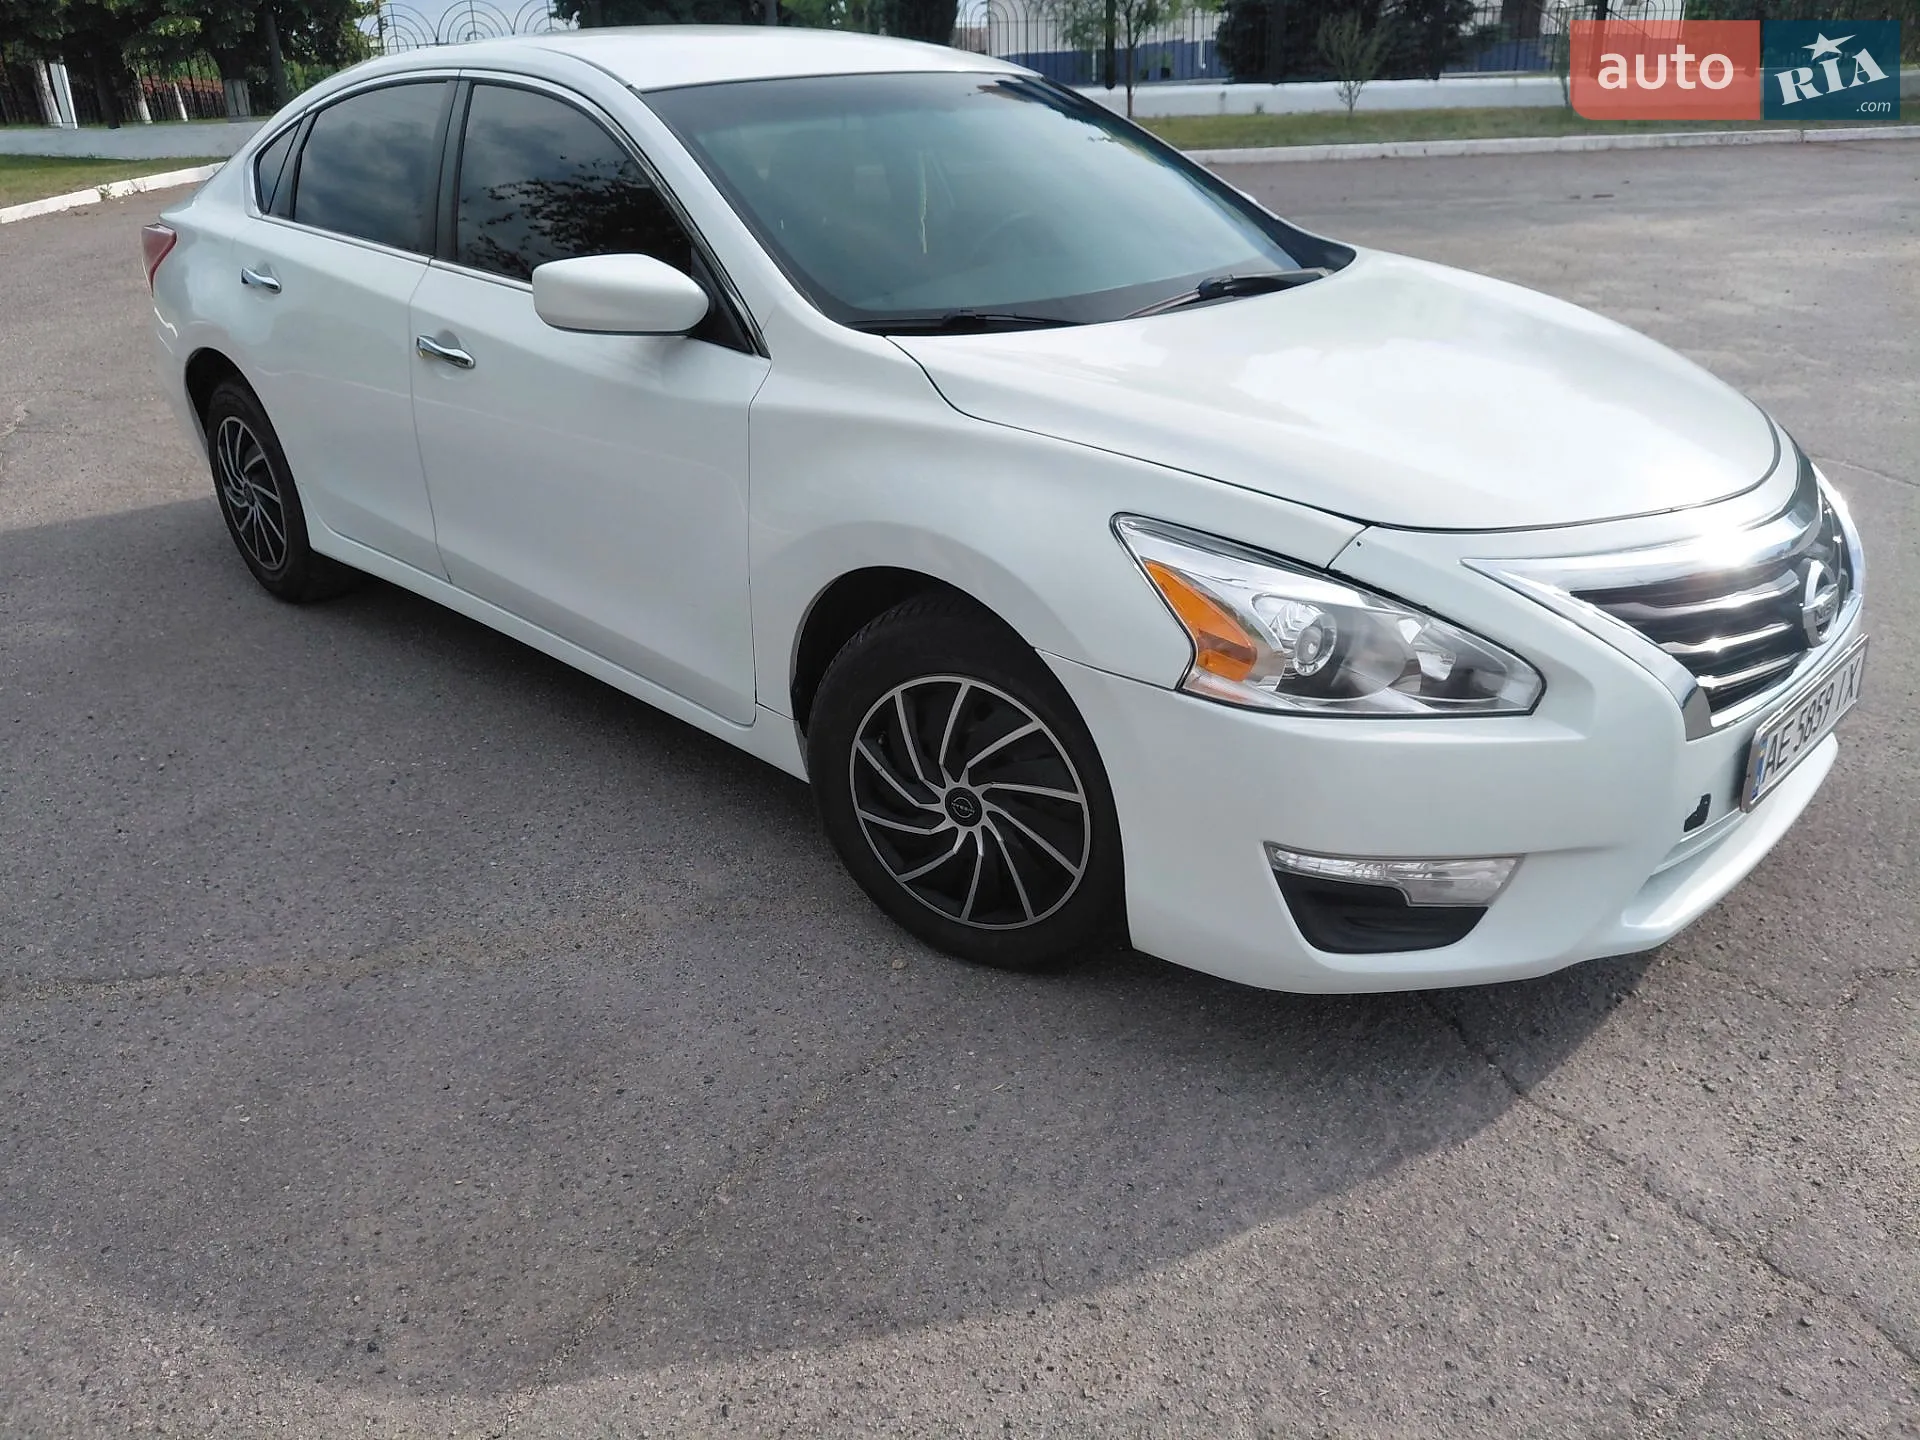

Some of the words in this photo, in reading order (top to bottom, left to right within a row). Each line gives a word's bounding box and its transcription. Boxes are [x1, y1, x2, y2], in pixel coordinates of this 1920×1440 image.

[1766, 718, 1795, 774] AE
[1793, 682, 1834, 752] 5859
[1836, 656, 1860, 711] IX
